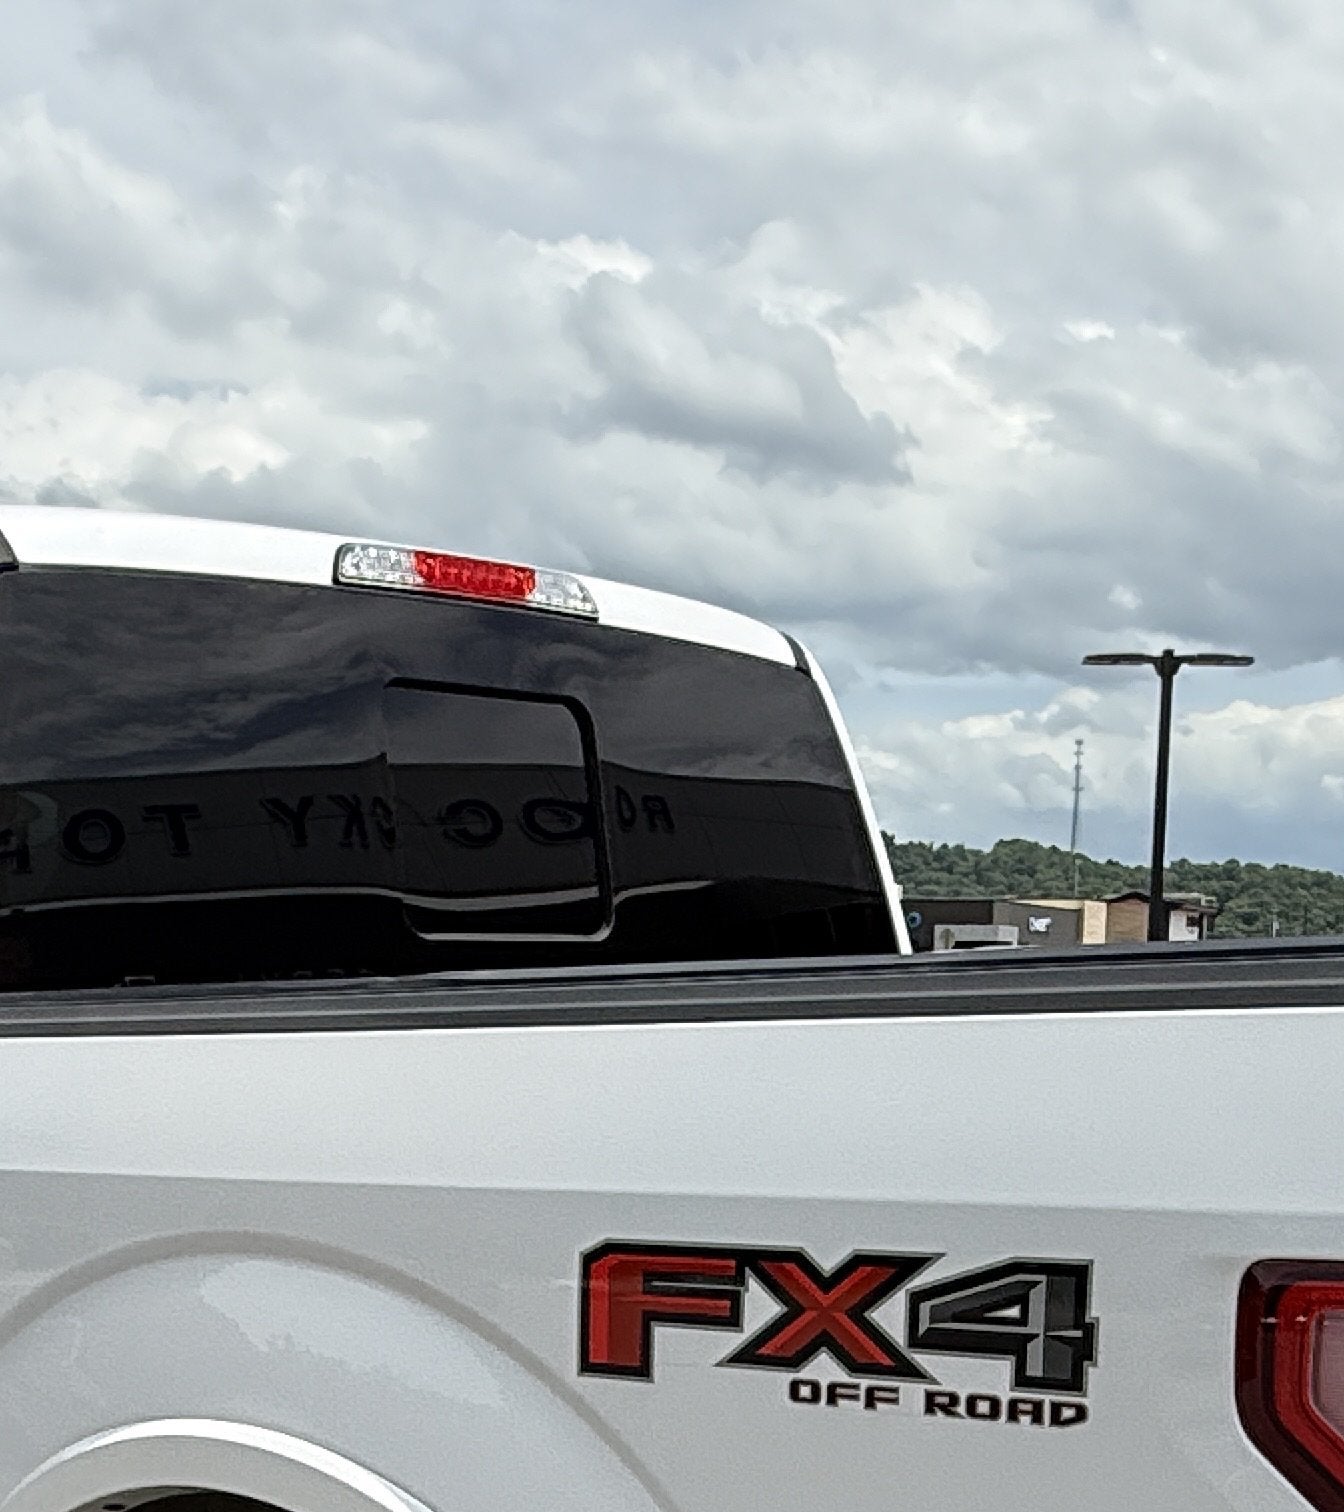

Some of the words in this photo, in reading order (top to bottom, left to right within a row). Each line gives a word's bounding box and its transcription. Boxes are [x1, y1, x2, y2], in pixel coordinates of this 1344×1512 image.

[577, 1237, 1100, 1397] FX4
[788, 1378, 900, 1412] OFF
[923, 1390, 1088, 1429] ROAD
